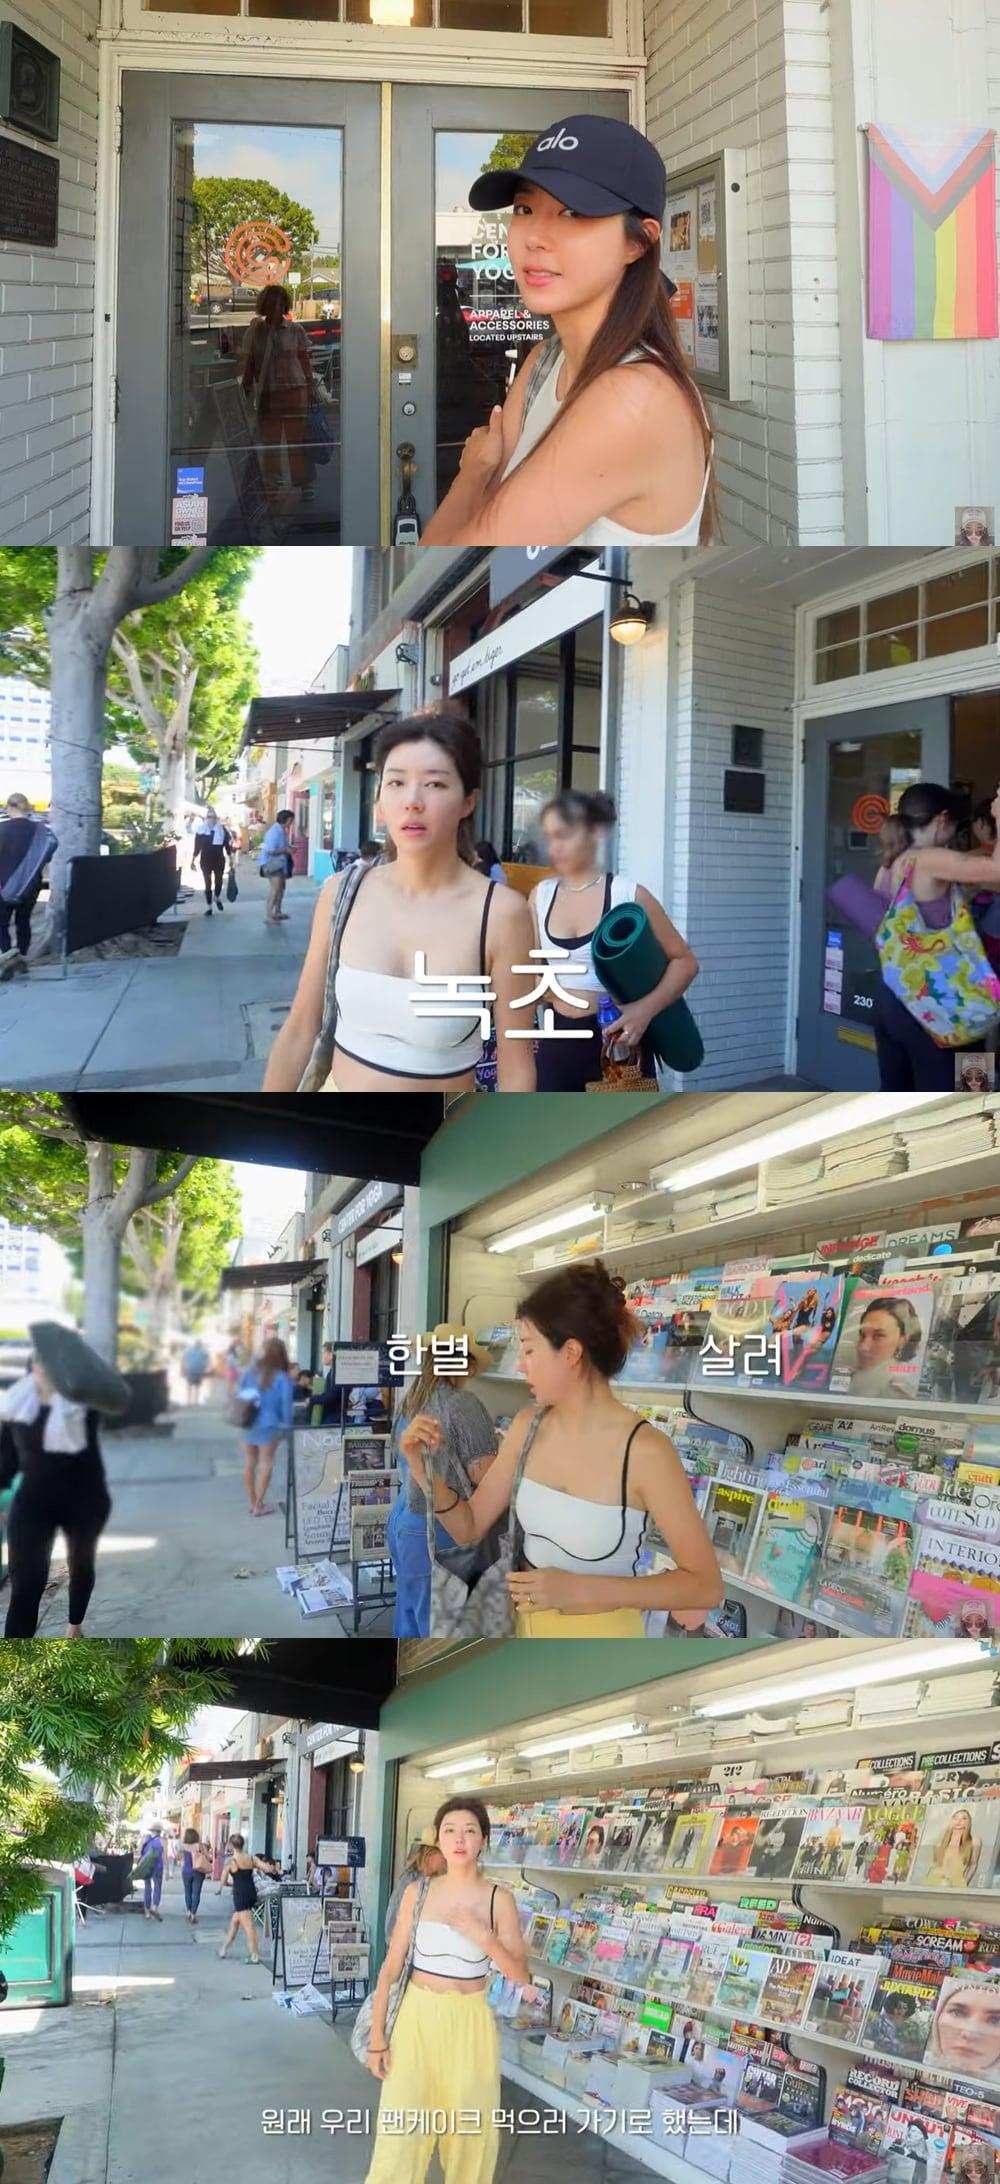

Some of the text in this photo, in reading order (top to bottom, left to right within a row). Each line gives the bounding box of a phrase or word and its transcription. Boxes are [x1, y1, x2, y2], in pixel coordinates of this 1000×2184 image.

[537, 128, 579, 152] alo
[472, 264, 515, 280] YOG
[470, 309, 532, 319] APPAREL &
[469, 320, 550, 331] ACCESSORIES
[469, 333, 544, 342] LOCATED UPSTAIRS
[853, 994, 873, 1008] 230
[338, 1182, 384, 1234] CENTER FOR YOGA
[852, 1251, 892, 1263] dedicate
[898, 1422, 936, 1436] domus
[716, 1486, 755, 1504] aspire
[934, 1750, 987, 1766] COLLECTIONS
[723, 1765, 743, 1776] 212
[867, 1804, 926, 1821] VOGUE
[916, 1935, 964, 1952] SCREAM
[770, 1957, 791, 1975] AD
[831, 1954, 861, 1967] IDEAT
[849, 2068, 900, 2090] RECORD
[848, 2077, 898, 2099] COLLECTOR
[891, 2109, 945, 2138] UNCUT
